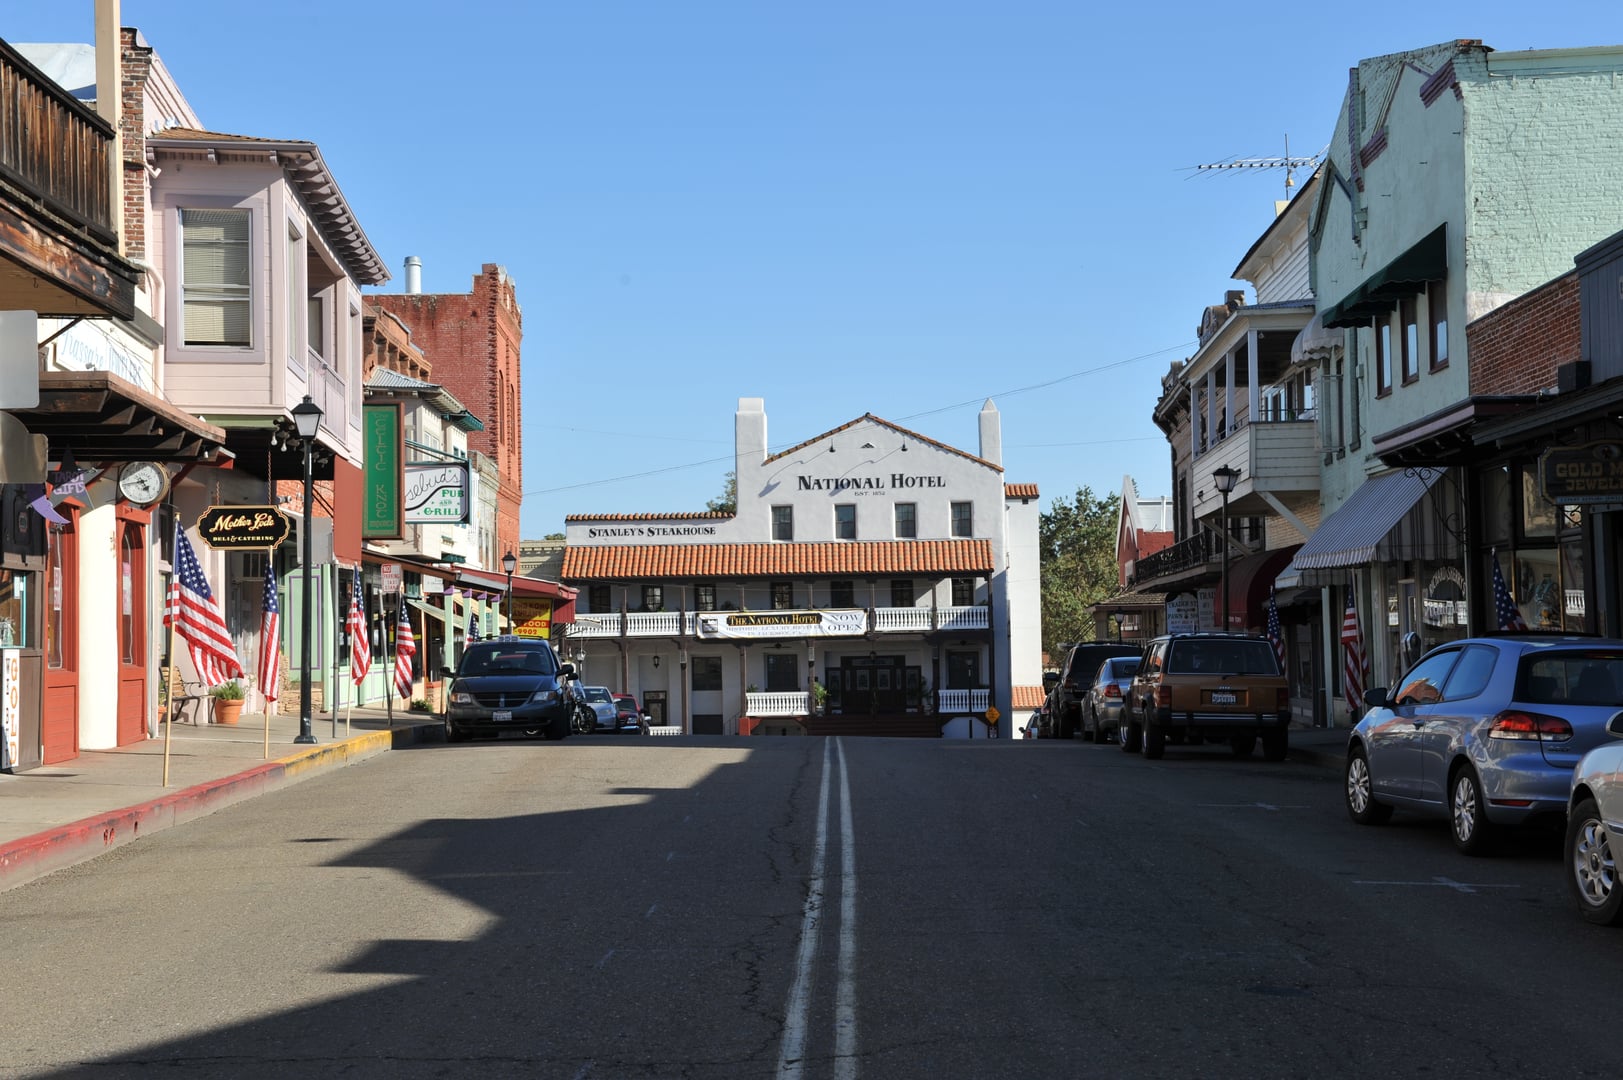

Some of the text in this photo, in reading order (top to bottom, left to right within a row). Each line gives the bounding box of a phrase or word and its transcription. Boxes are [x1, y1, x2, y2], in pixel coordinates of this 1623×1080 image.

[1556, 462, 1603, 478] GOLD
[797, 473, 946, 490] NATIONAL HOTEL
[53, 482, 85, 496] GIFTS
[442, 489, 464, 497] PUB
[424, 507, 461, 516] GRILL
[209, 512, 275, 533] Mother Lode
[588, 526, 716, 538] STANLEY'S STEAKHOUSE
[728, 613, 821, 626] THE NATIONAL HOTEL
[830, 614, 860, 622] NOW
[827, 624, 863, 632] OPEN
[9, 658, 18, 765] GOLD
